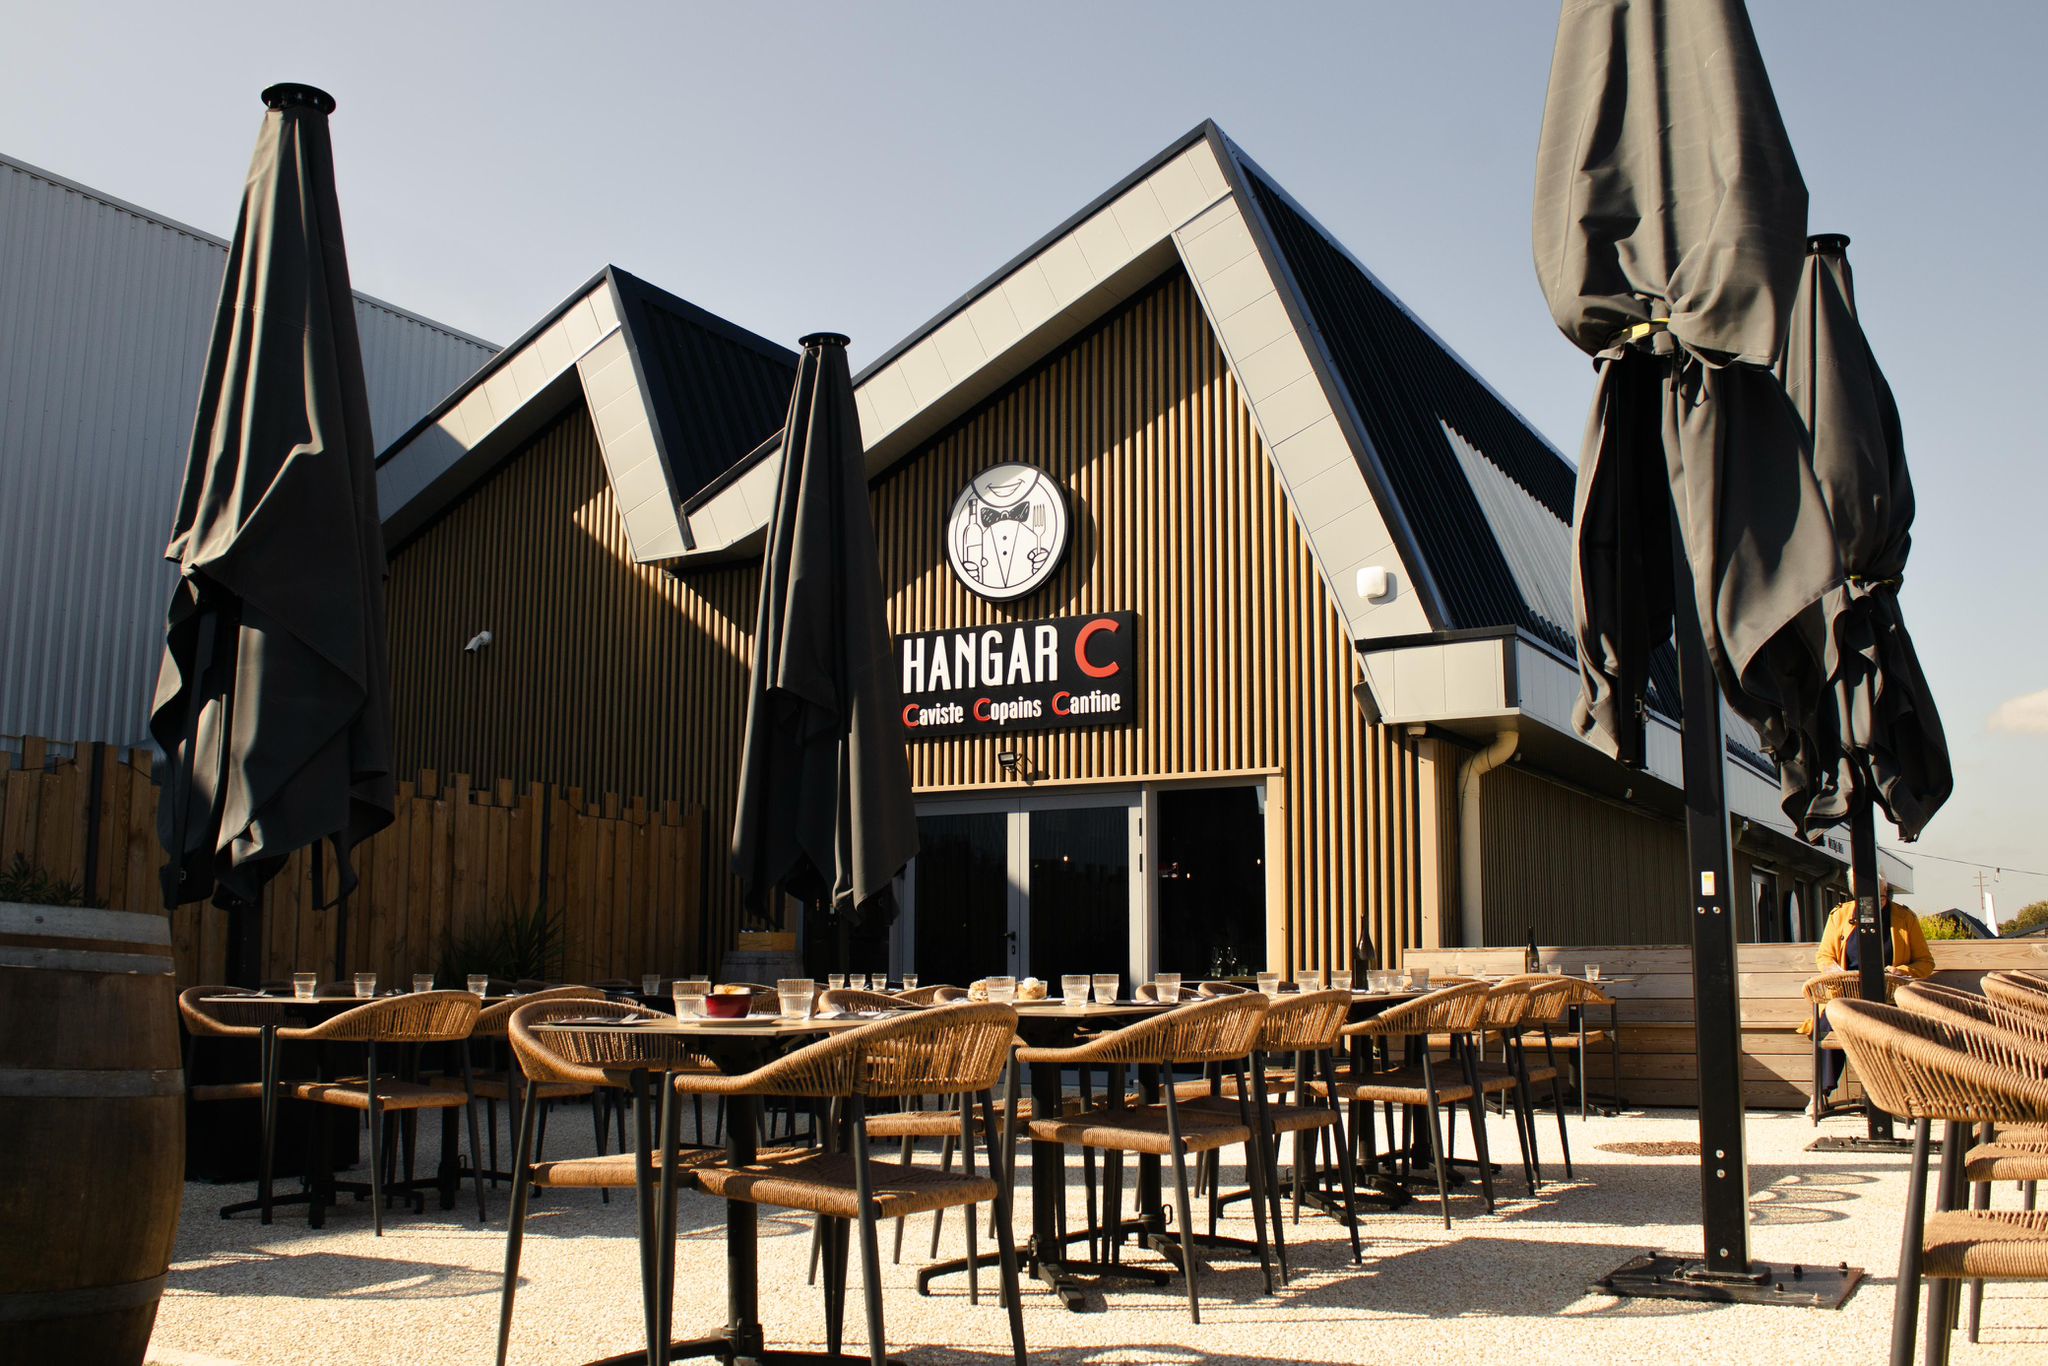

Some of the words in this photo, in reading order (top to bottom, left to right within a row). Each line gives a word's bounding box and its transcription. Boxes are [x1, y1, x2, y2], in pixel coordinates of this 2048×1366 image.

[902, 624, 1058, 694] HANGAR
[1074, 618, 1120, 679] C
[902, 702, 964, 729] Caviste
[973, 696, 1042, 726] Copains
[1051, 689, 1121, 717] Cantine
